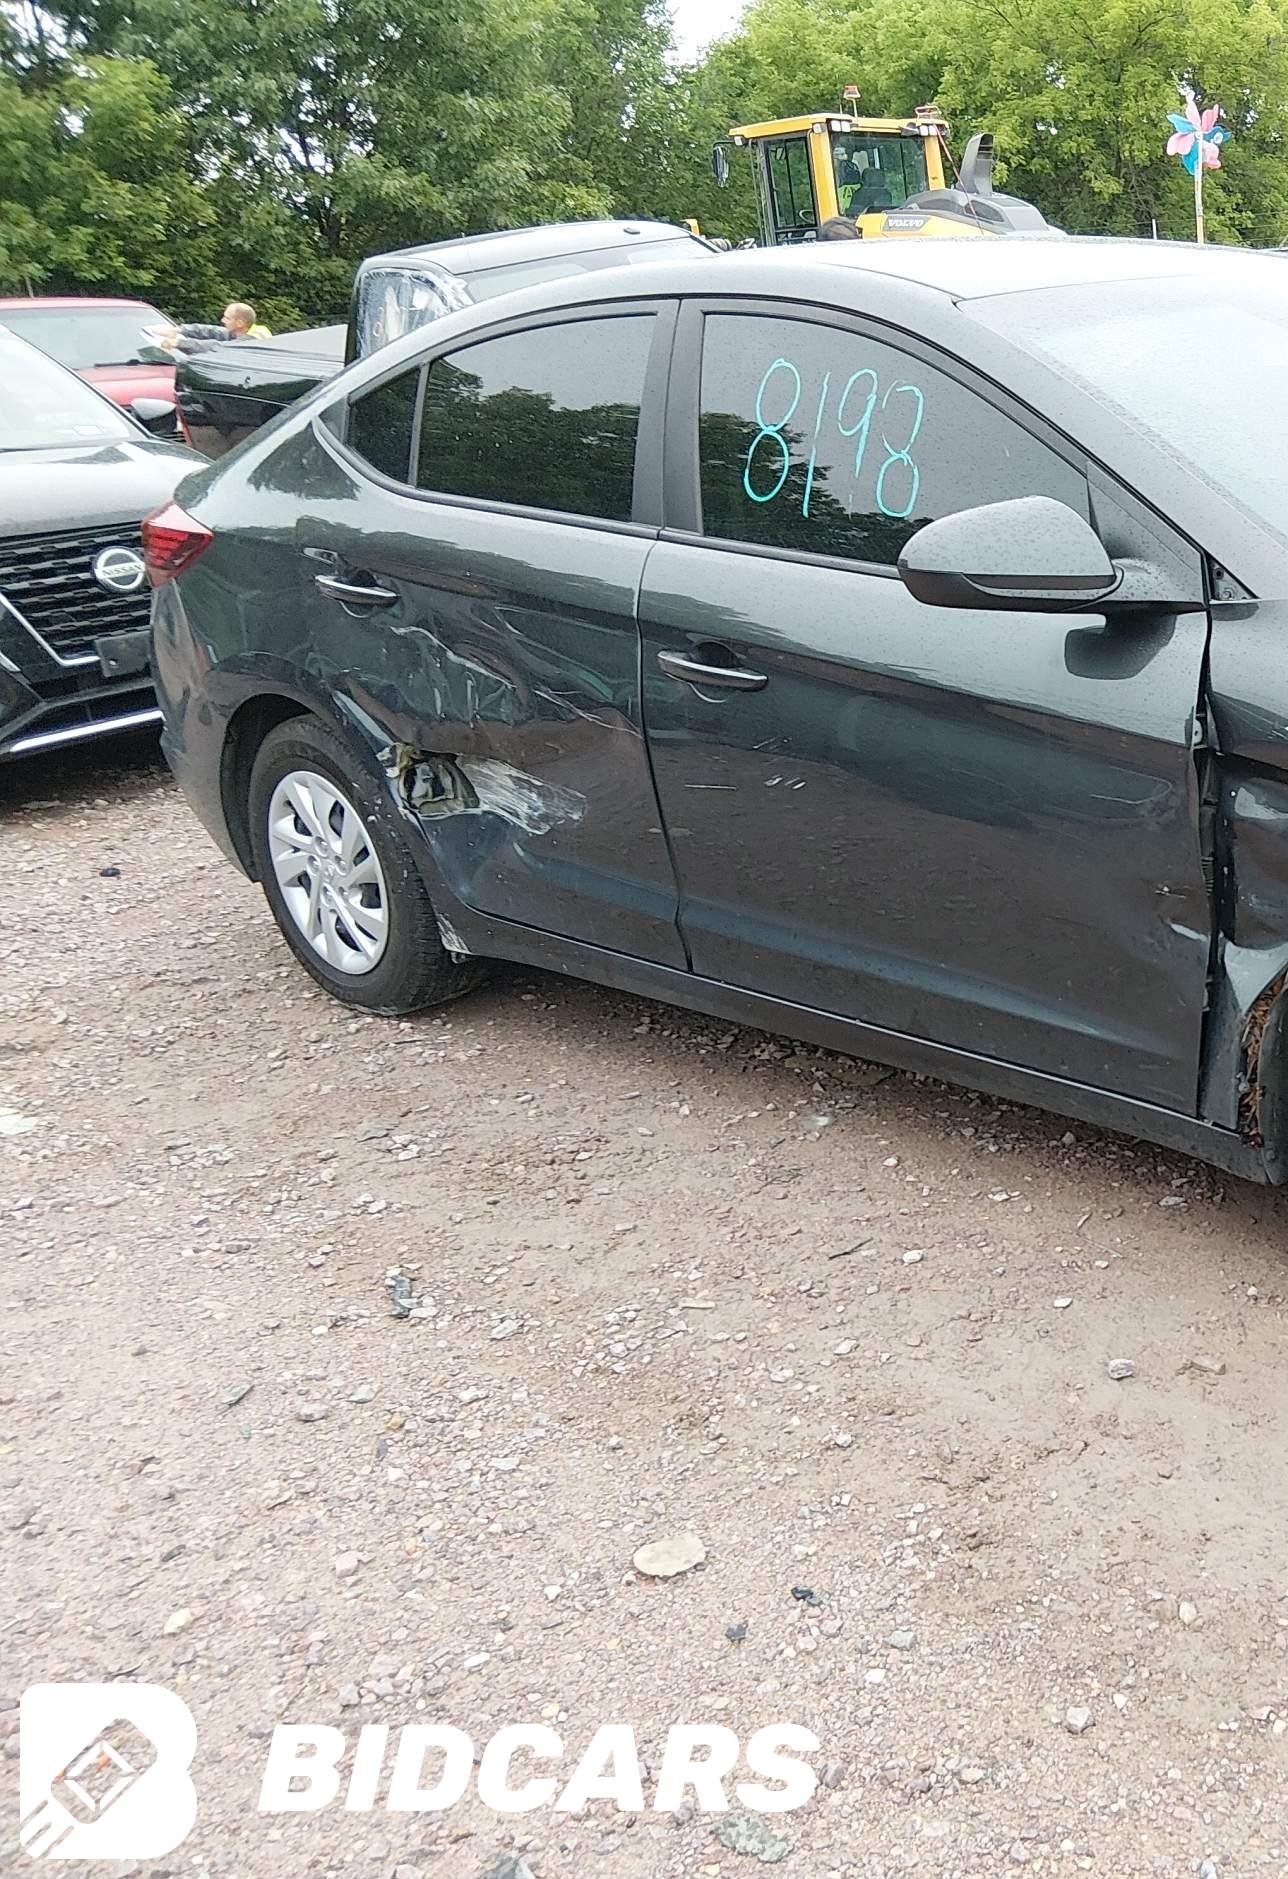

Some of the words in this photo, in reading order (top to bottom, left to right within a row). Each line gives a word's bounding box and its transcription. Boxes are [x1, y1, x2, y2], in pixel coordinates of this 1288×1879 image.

[888, 219, 924, 228] VOLVO
[743, 357, 925, 519] 8198
[100, 563, 143, 578] NISSAN
